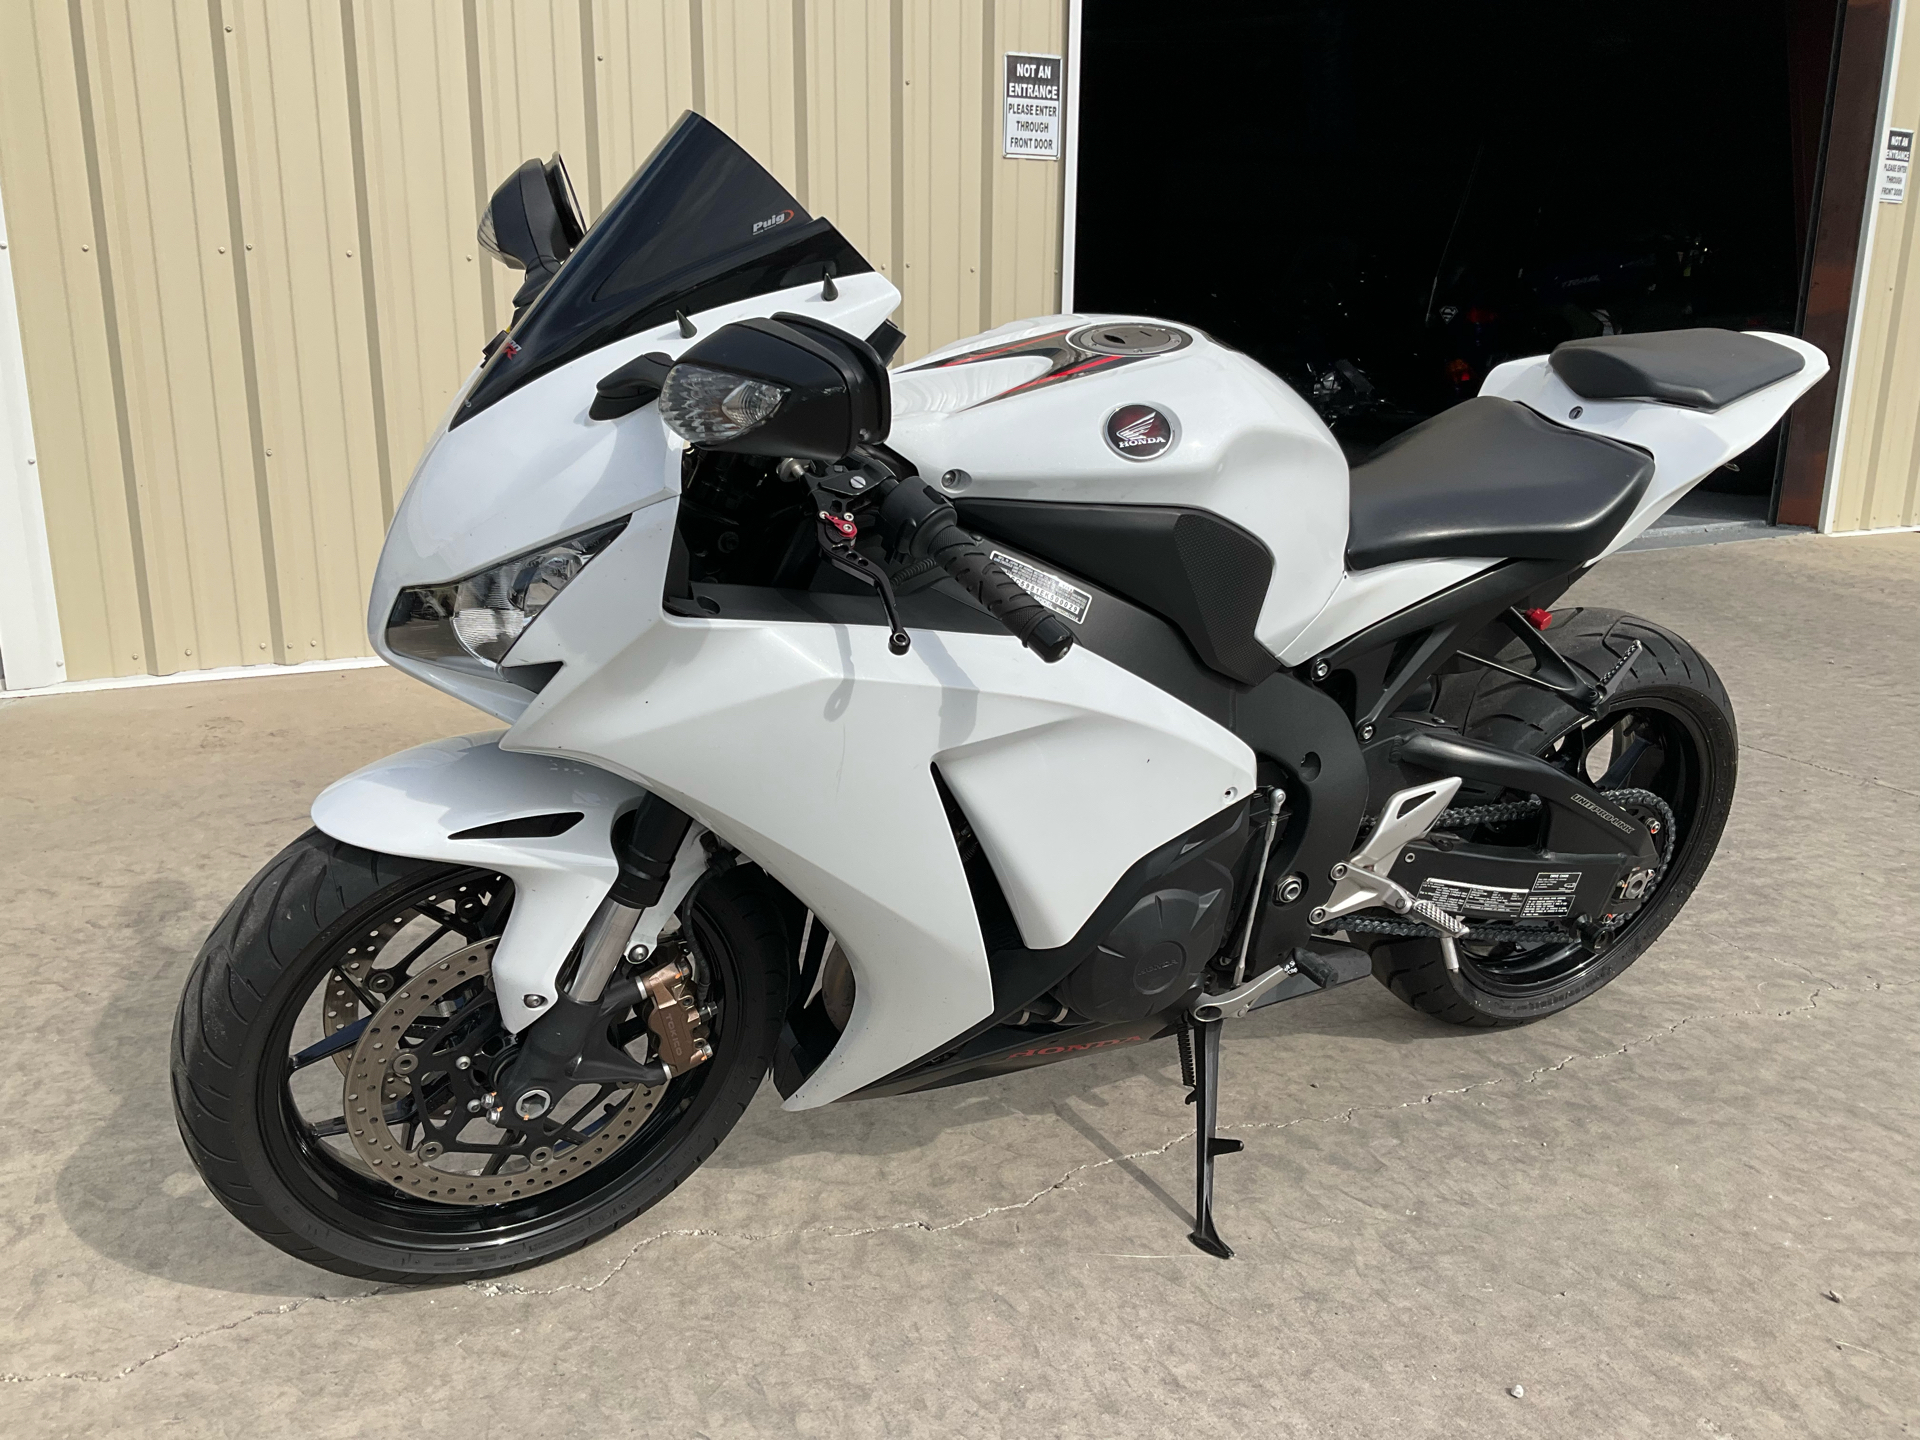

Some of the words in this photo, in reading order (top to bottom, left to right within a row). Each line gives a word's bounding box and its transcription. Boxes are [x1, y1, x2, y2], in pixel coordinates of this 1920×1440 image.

[1016, 63, 1036, 77] NOT
[1038, 65, 1051, 79] AN
[1009, 83, 1058, 99] ENTRANCE
[1008, 103, 1034, 115] PLEASE
[1035, 105, 1057, 117] ENTER
[1016, 120, 1049, 133] THROUGH
[1010, 137, 1033, 149] FRONT
[1034, 138, 1053, 150] DOOR
[1891, 136, 1902, 146] NOT
[1901, 137, 1910, 147] AN
[1886, 150, 1910, 161] ENTRANCE
[1884, 163, 1897, 172] PLEASE
[753, 213, 785, 233] Puig
[1118, 436, 1167, 448] HONDA
[1570, 793, 1596, 810] UNIT
[666, 1013, 682, 1056] TOKICO
[1006, 1035, 1144, 1060] HONDA
